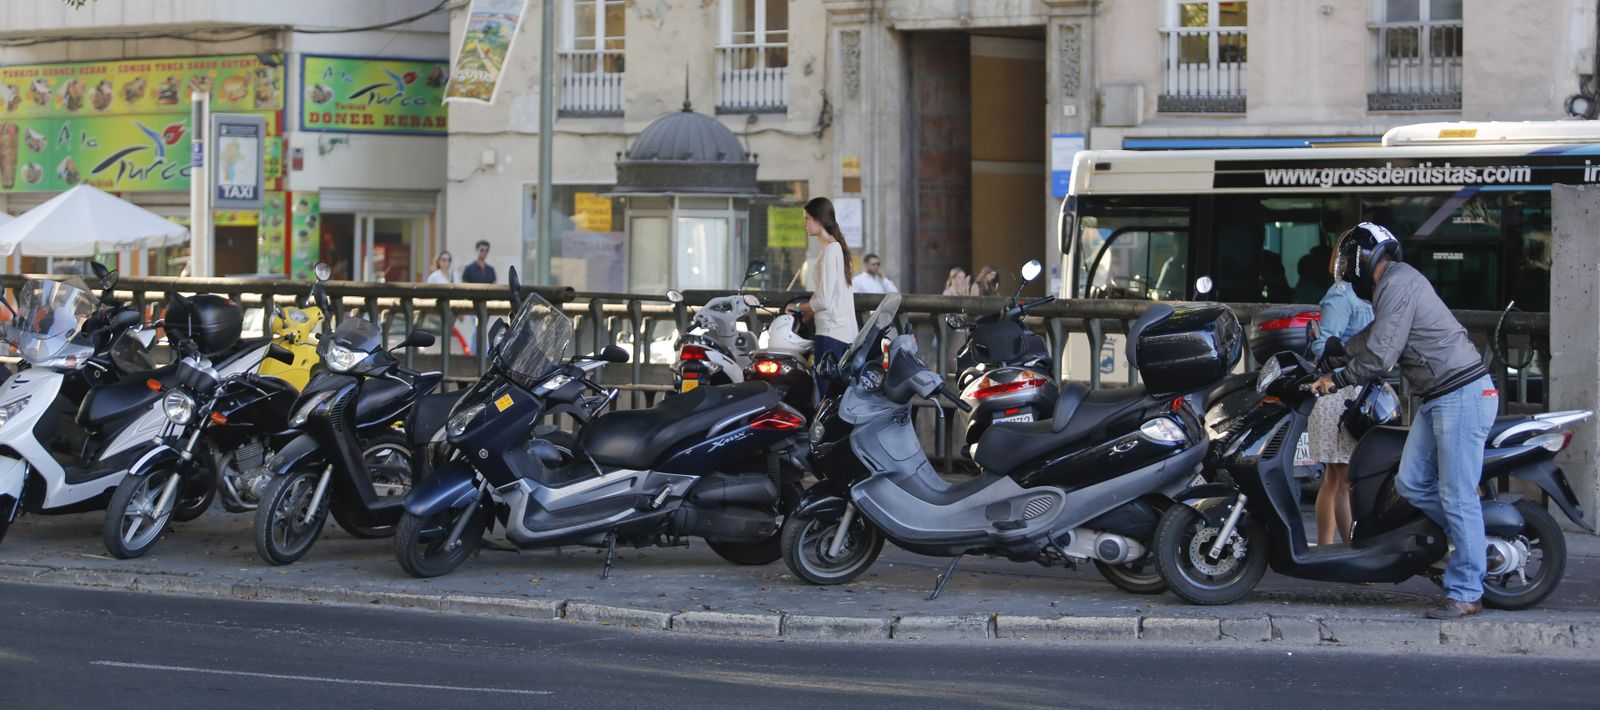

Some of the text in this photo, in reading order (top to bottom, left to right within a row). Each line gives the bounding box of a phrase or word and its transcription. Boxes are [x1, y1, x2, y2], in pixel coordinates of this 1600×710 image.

[384, 114, 447, 128] KEBAB
[1264, 161, 1532, 189] www.grossdentistas.com
[222, 185, 254, 199] TAXI
